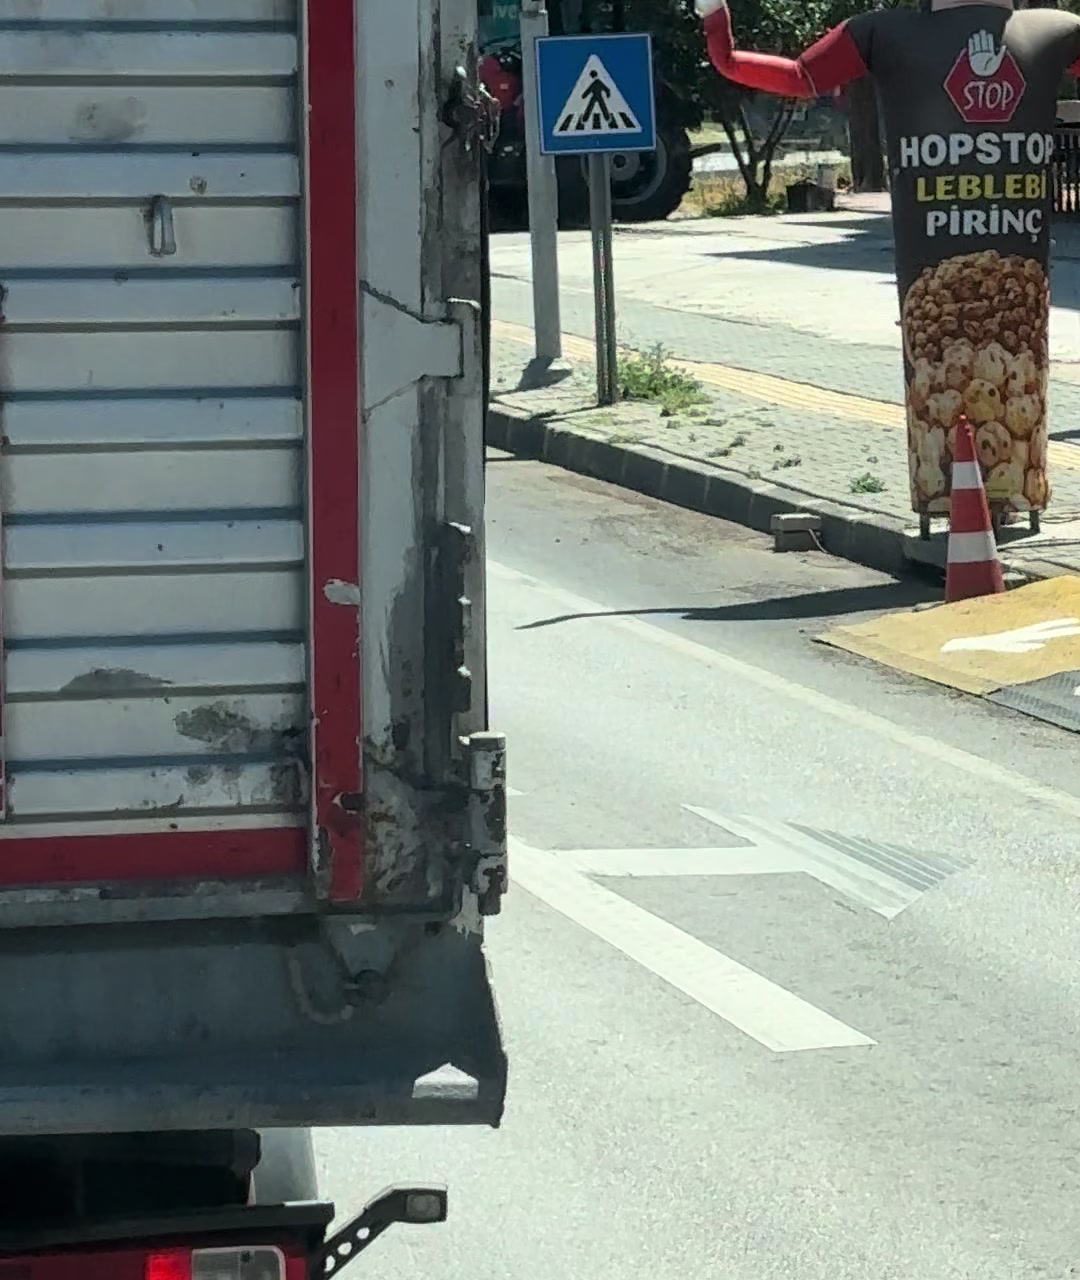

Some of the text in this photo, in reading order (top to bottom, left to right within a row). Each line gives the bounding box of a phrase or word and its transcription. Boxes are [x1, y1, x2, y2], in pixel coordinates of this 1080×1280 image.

[964, 81, 1014, 110] STOP
[900, 132, 1054, 168] HOPSTOP
[916, 169, 1046, 202] LEBLEBİ
[926, 203, 1042, 243] PİRİNÇ
